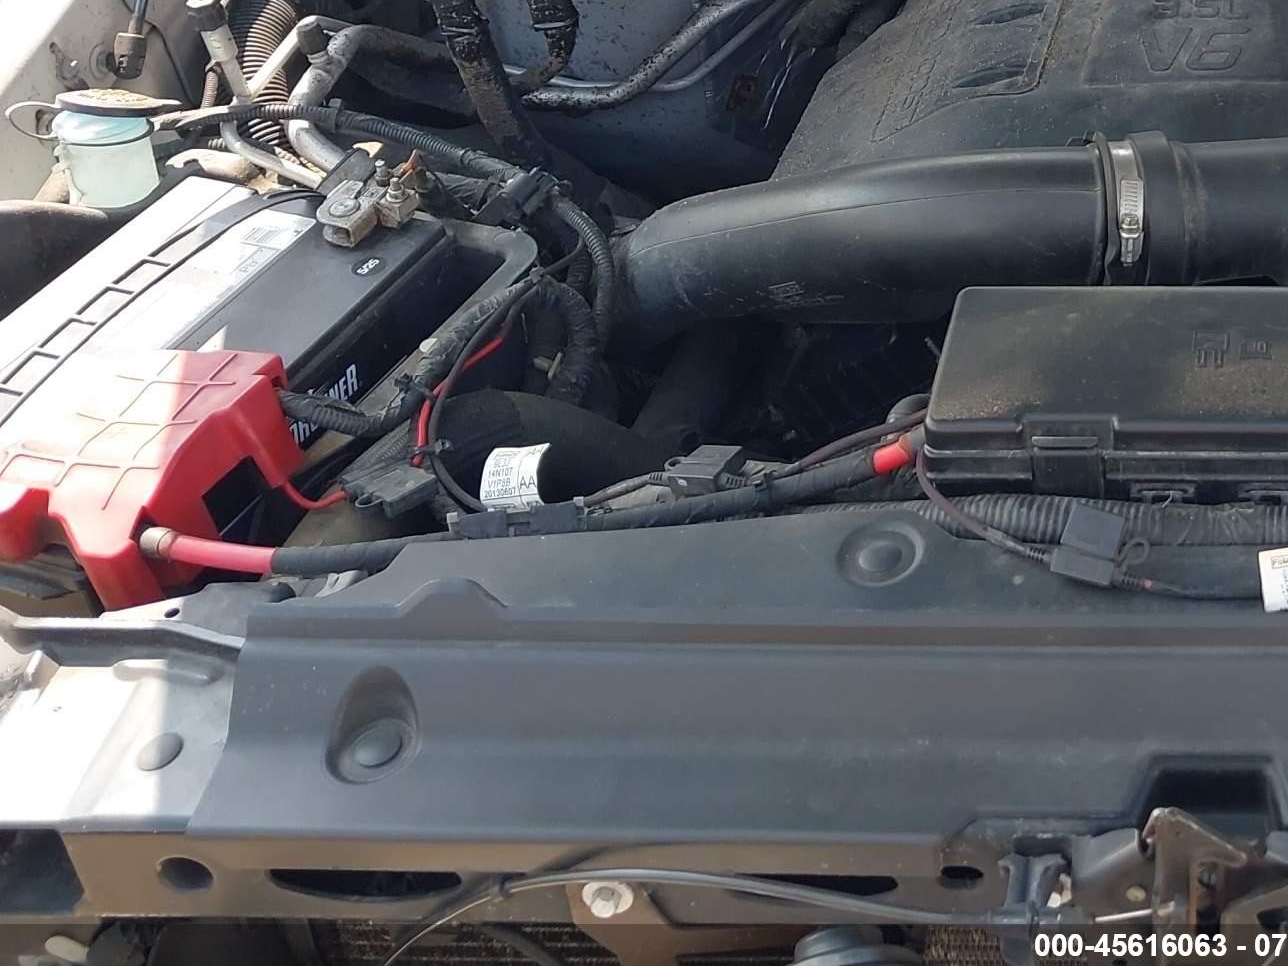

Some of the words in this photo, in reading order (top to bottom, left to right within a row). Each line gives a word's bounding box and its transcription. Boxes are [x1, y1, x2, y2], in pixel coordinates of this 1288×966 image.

[1138, 25, 1252, 73] V6
[356, 257, 381, 276] 5/25
[519, 475, 538, 490] AA
